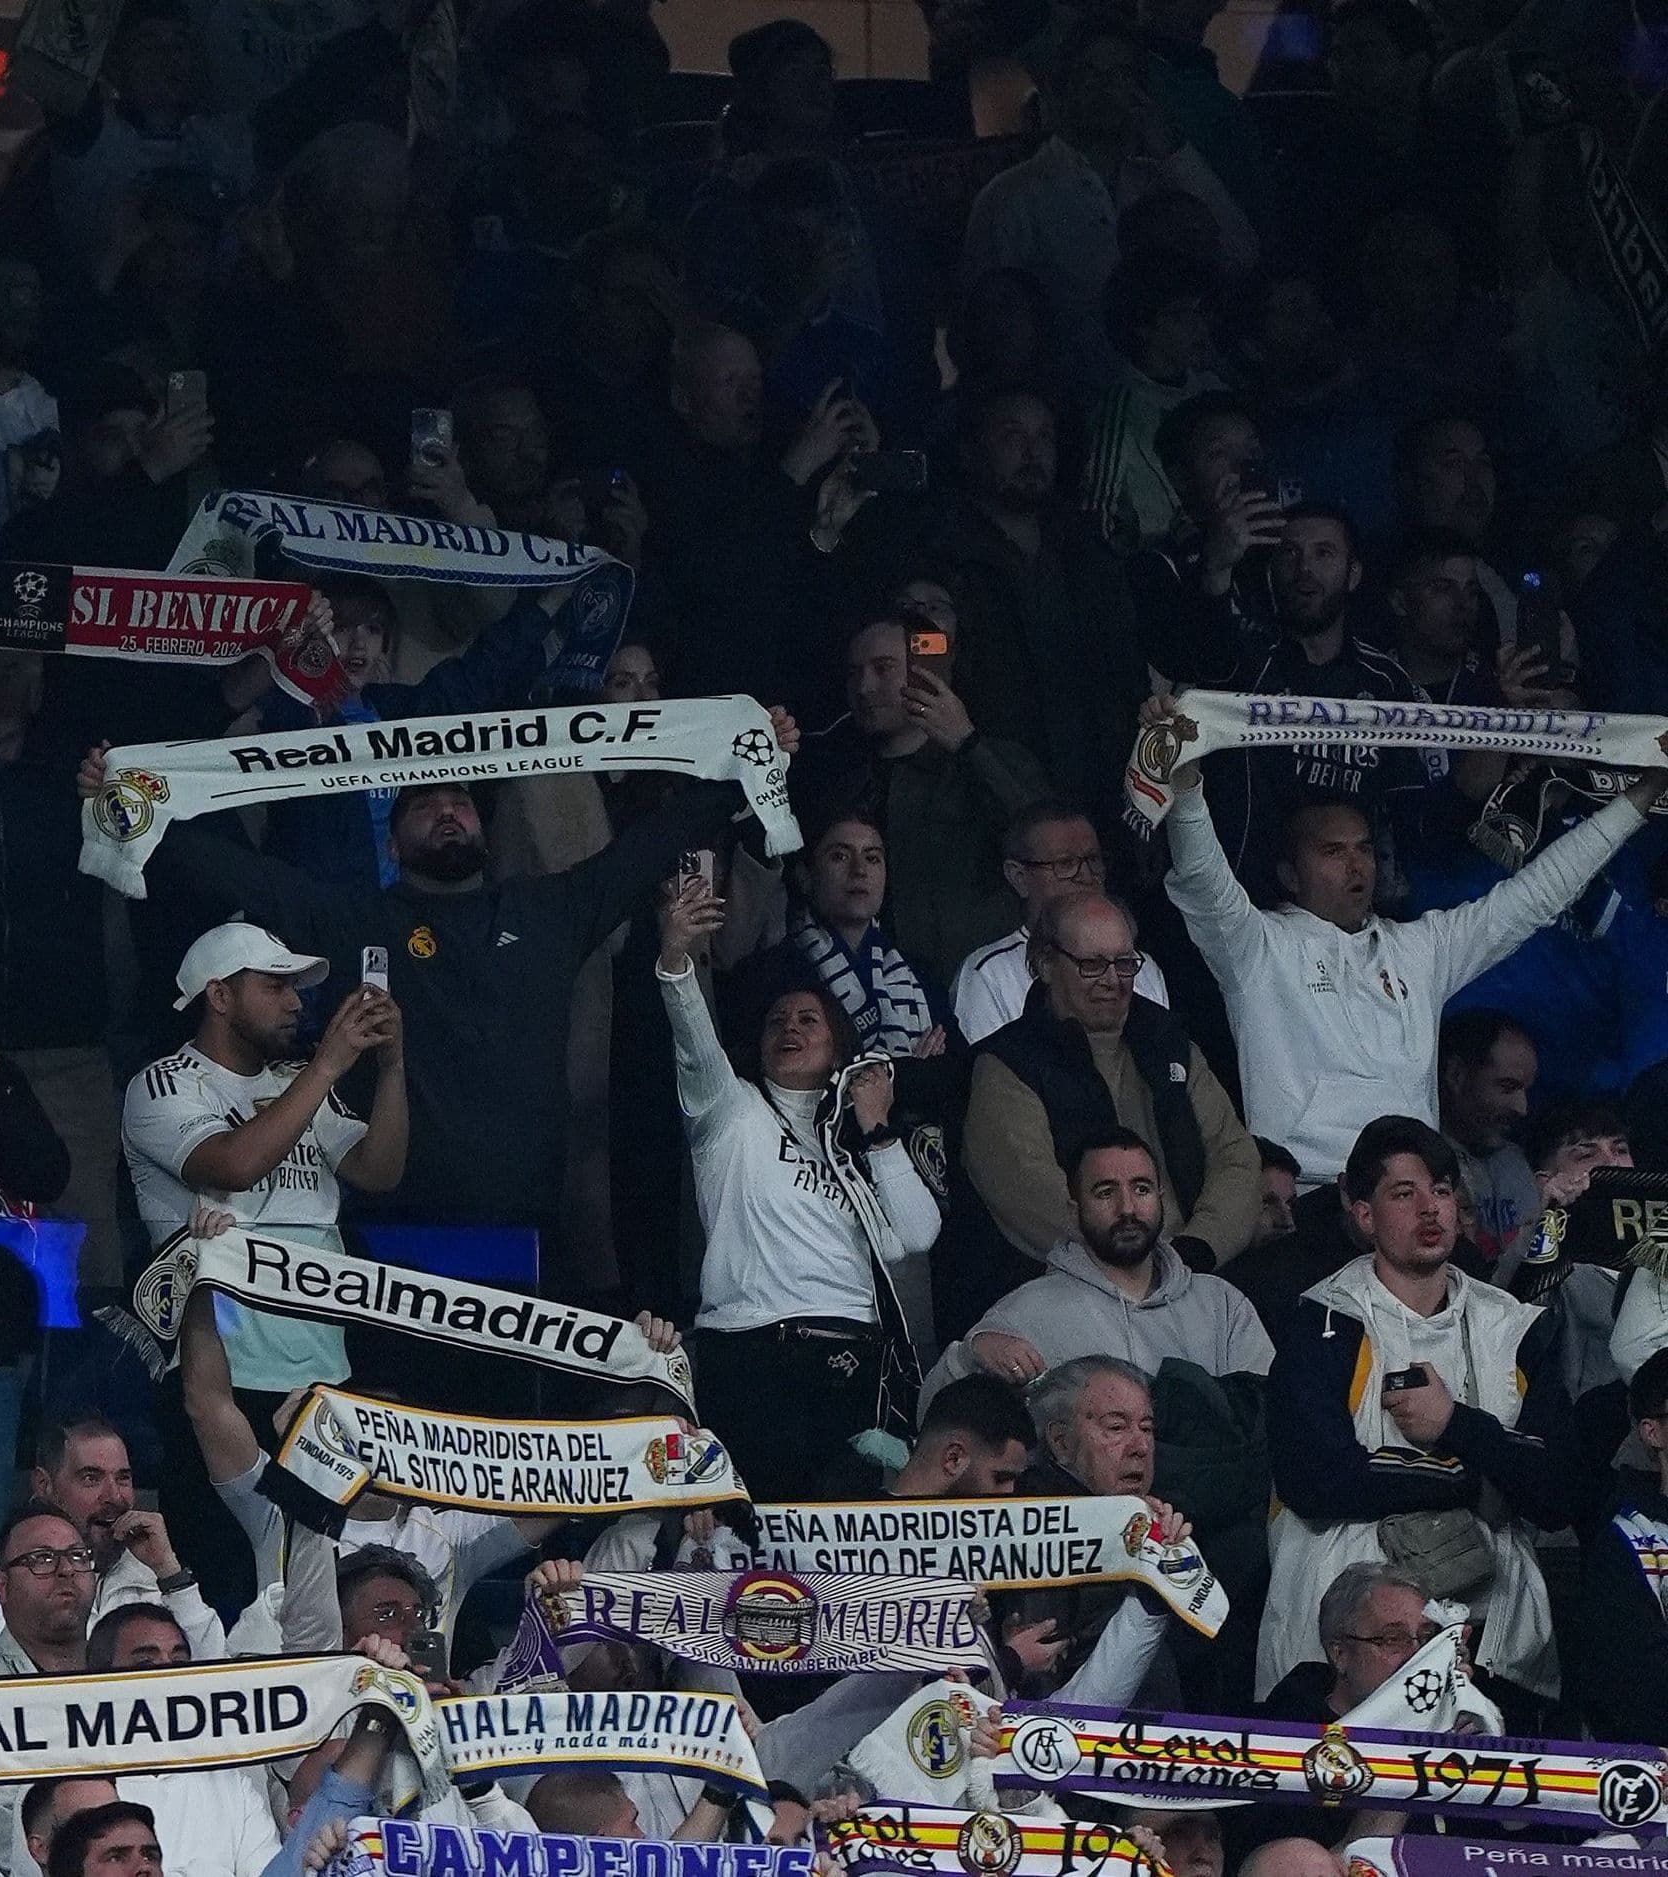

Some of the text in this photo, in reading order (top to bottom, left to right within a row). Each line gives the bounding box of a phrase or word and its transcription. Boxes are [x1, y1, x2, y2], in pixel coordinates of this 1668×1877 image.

[331, 510, 511, 557] MADRID
[70, 584, 298, 636] SL BENFICA
[119, 635, 243, 658] 25 FEBRERO 2026
[1249, 701, 1359, 727] REAL
[1374, 705, 1533, 733] MADRID
[230, 709, 662, 775] Real Madrid C.F.
[321, 755, 584, 789] UEFA CHAMPIONS LEAGUE
[246, 1238, 624, 1363] Realmadrid
[355, 1406, 612, 1462] PEÑA MADRIDISTA DEL
[295, 1435, 356, 1482] FUNDADA 1975
[357, 1441, 633, 1504] EAL SITIO DE ARANJUEZ
[835, 1510, 1020, 1542] MADRIDISTA
[1023, 1505, 1080, 1536] DEL
[814, 1547, 889, 1575] SITIO
[897, 1545, 938, 1577] DE
[947, 1538, 1104, 1580] ARANJUEZ
[582, 1585, 979, 1649] REAL MADRID
[1187, 1572, 1215, 1616] FUNDAD
[730, 1654, 802, 1674] SANTIAGO
[806, 1645, 889, 1672] BERNABEU
[67, 1684, 309, 1749] MADRID
[441, 1695, 546, 1744] HALA
[565, 1693, 736, 1743] MADRID!
[555, 1733, 608, 1749] nada
[619, 1733, 659, 1749] más
[1404, 1751, 1543, 1807] 1971
[379, 1819, 816, 1877] CAMPEONES
[1463, 1845, 1550, 1867] Peña
